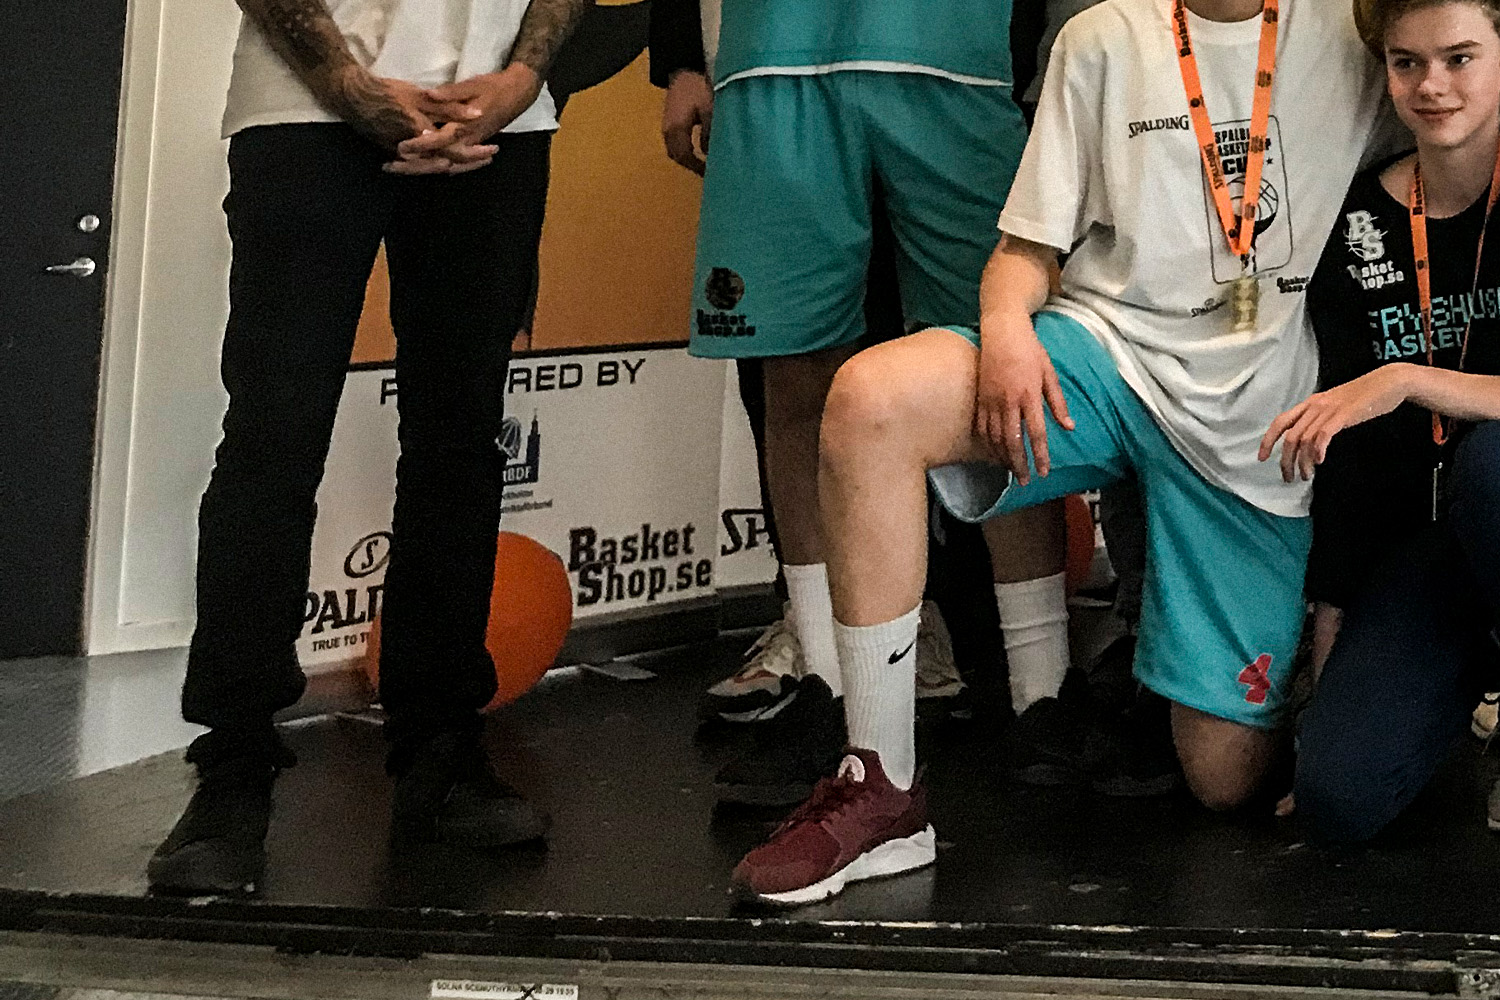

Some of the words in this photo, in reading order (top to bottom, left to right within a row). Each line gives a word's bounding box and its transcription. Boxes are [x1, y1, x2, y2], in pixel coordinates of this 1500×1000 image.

[1128, 114, 1190, 138] SPALDING
[1222, 156, 1249, 176] CU
[596, 357, 646, 387] BY
[568, 523, 695, 572] Basket
[576, 559, 711, 606] Shop.se
[312, 636, 341, 652] TRUE
